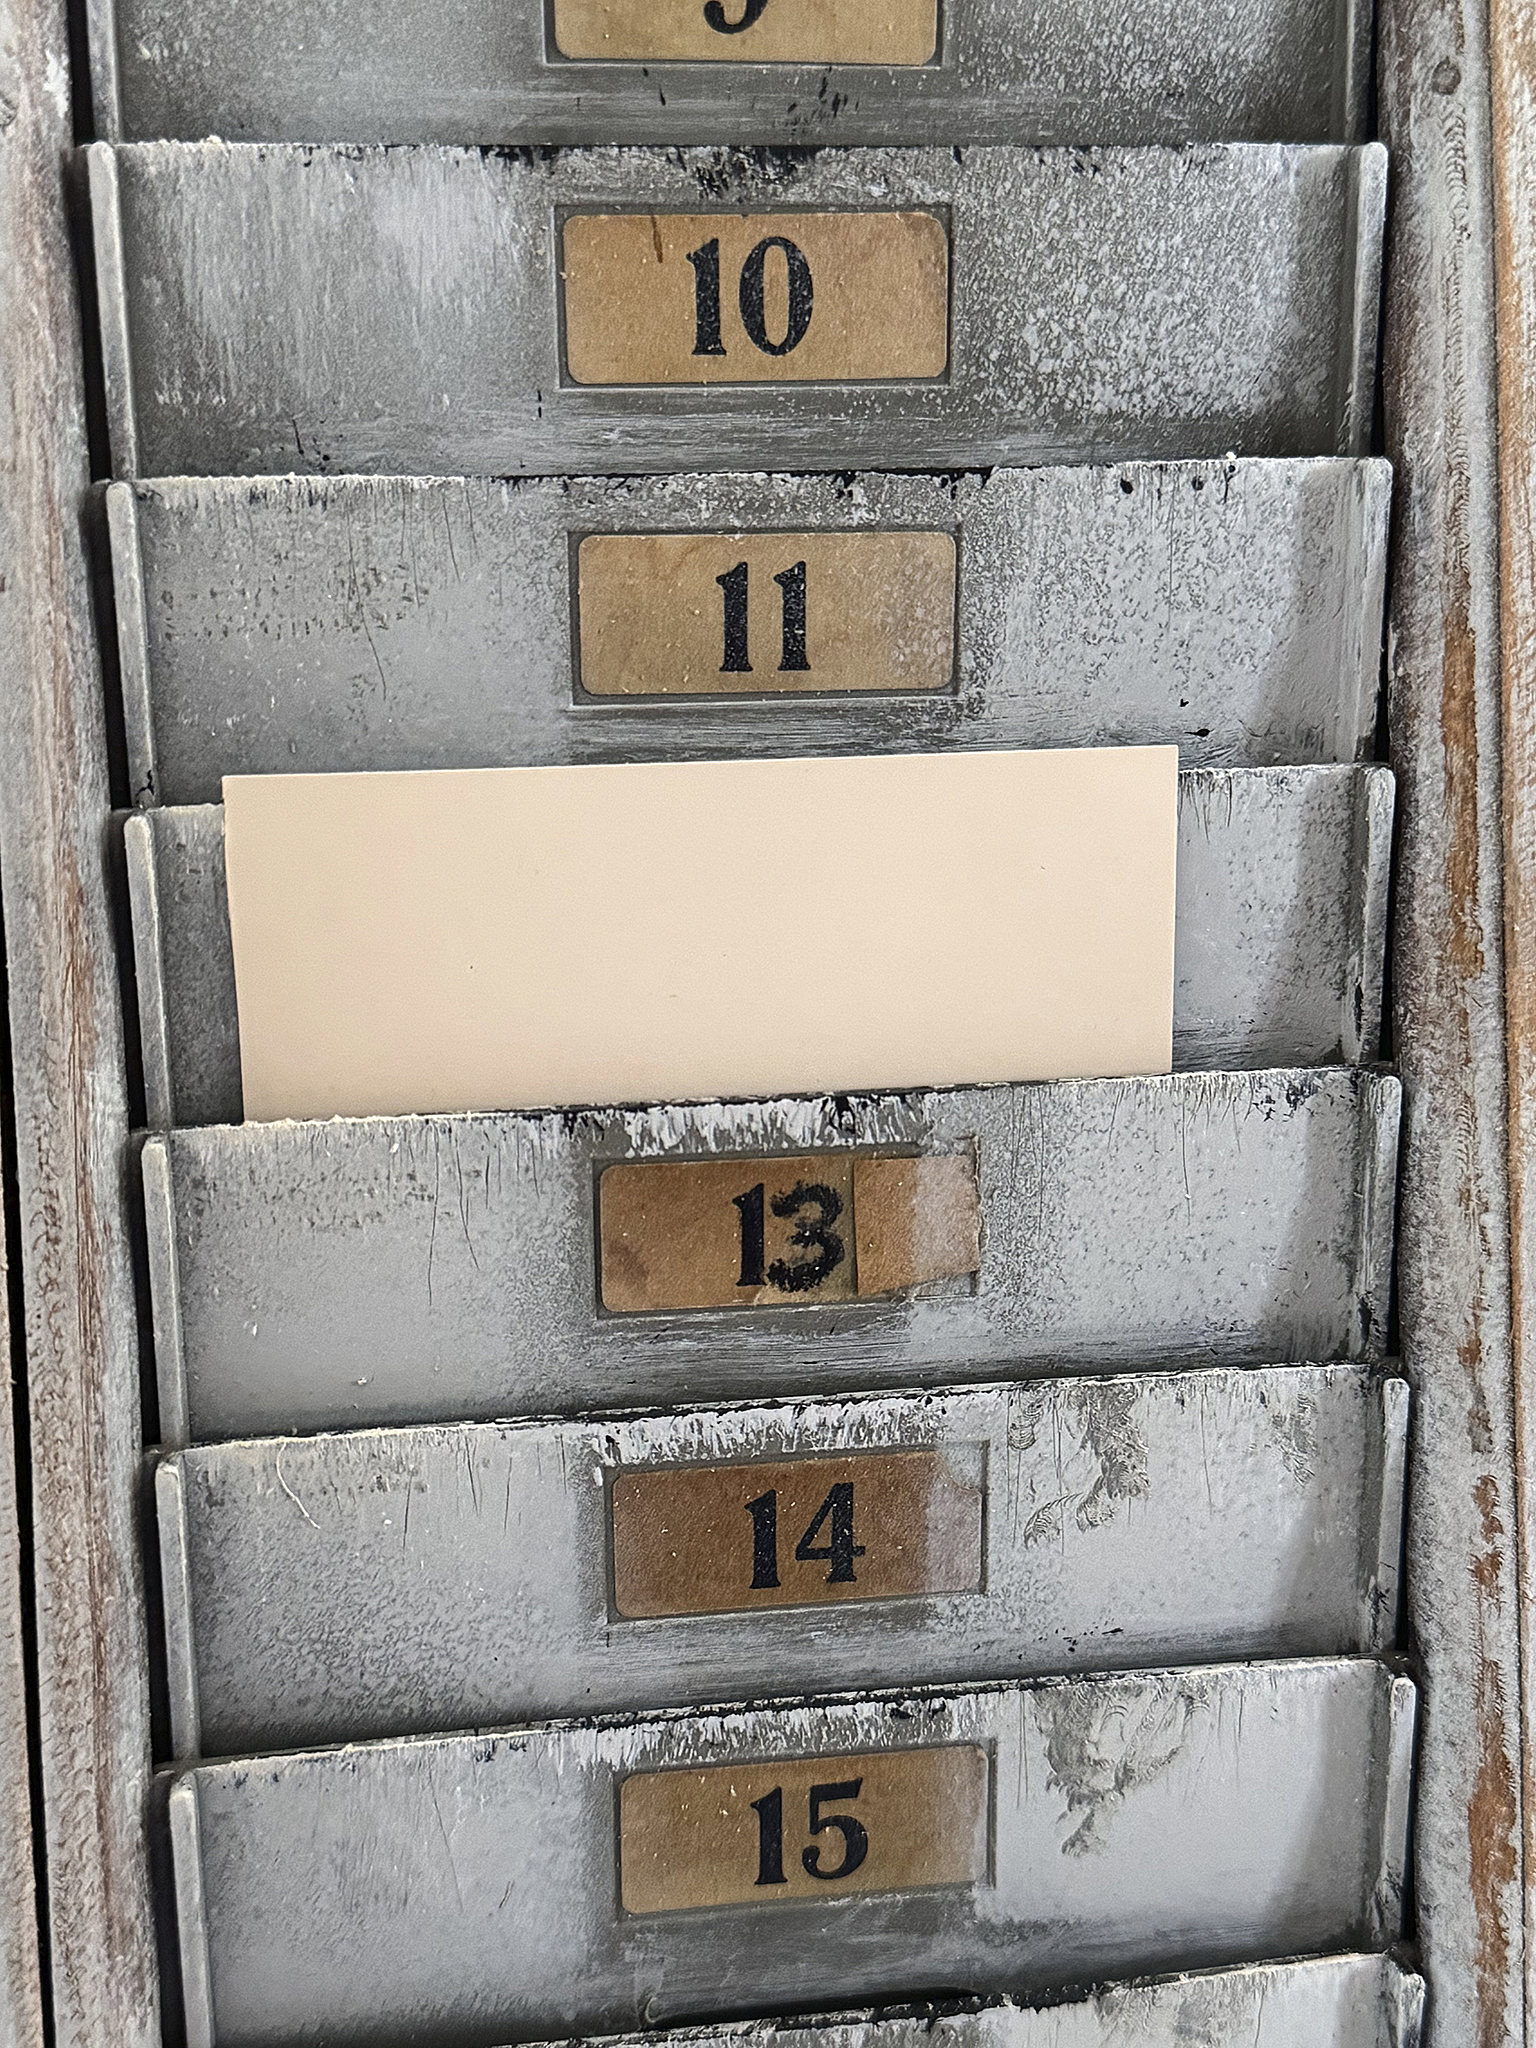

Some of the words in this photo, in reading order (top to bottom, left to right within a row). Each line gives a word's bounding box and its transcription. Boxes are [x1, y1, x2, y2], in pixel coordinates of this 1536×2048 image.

[685, 235, 814, 357] 10
[715, 560, 812, 674] 11
[731, 1180, 846, 1292] 13
[743, 1482, 866, 1590] 14
[749, 1777, 869, 1886] 15
